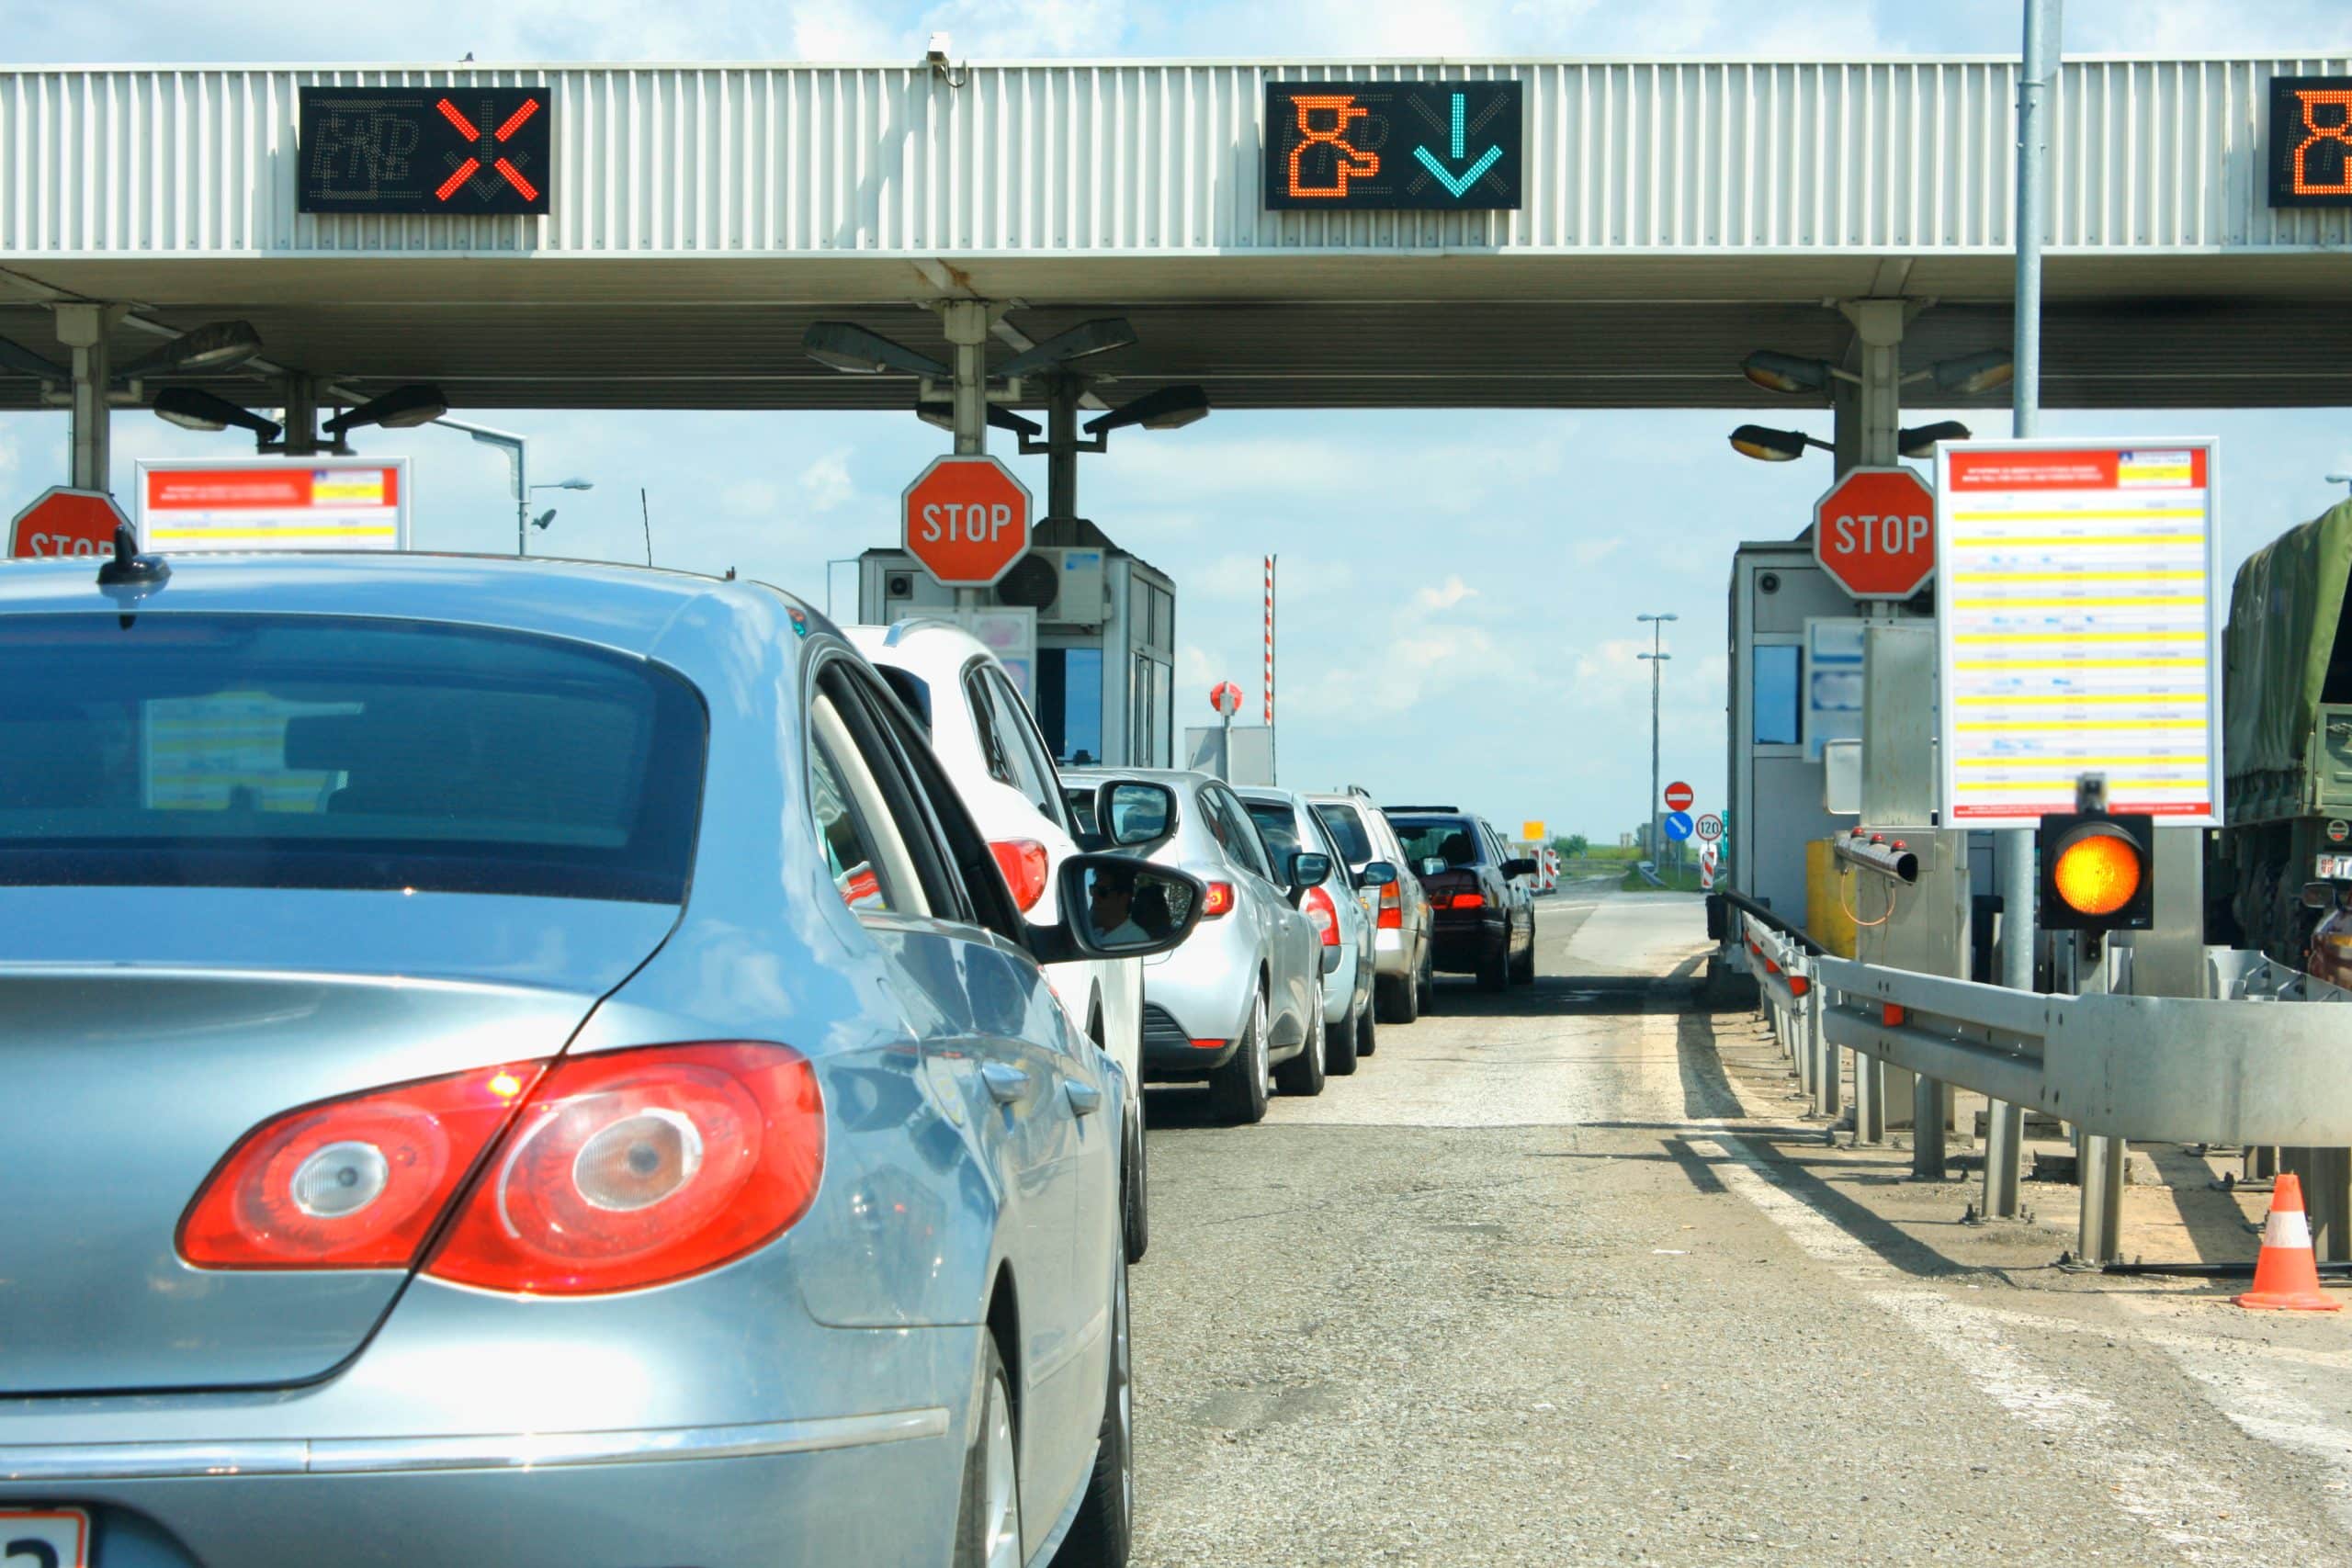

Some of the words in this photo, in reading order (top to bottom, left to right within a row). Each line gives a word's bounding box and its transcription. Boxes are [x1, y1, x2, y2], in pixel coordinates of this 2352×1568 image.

[922, 503, 1012, 542] STOP
[1835, 514, 1928, 554] STOP
[1701, 821, 1719, 835] 120
